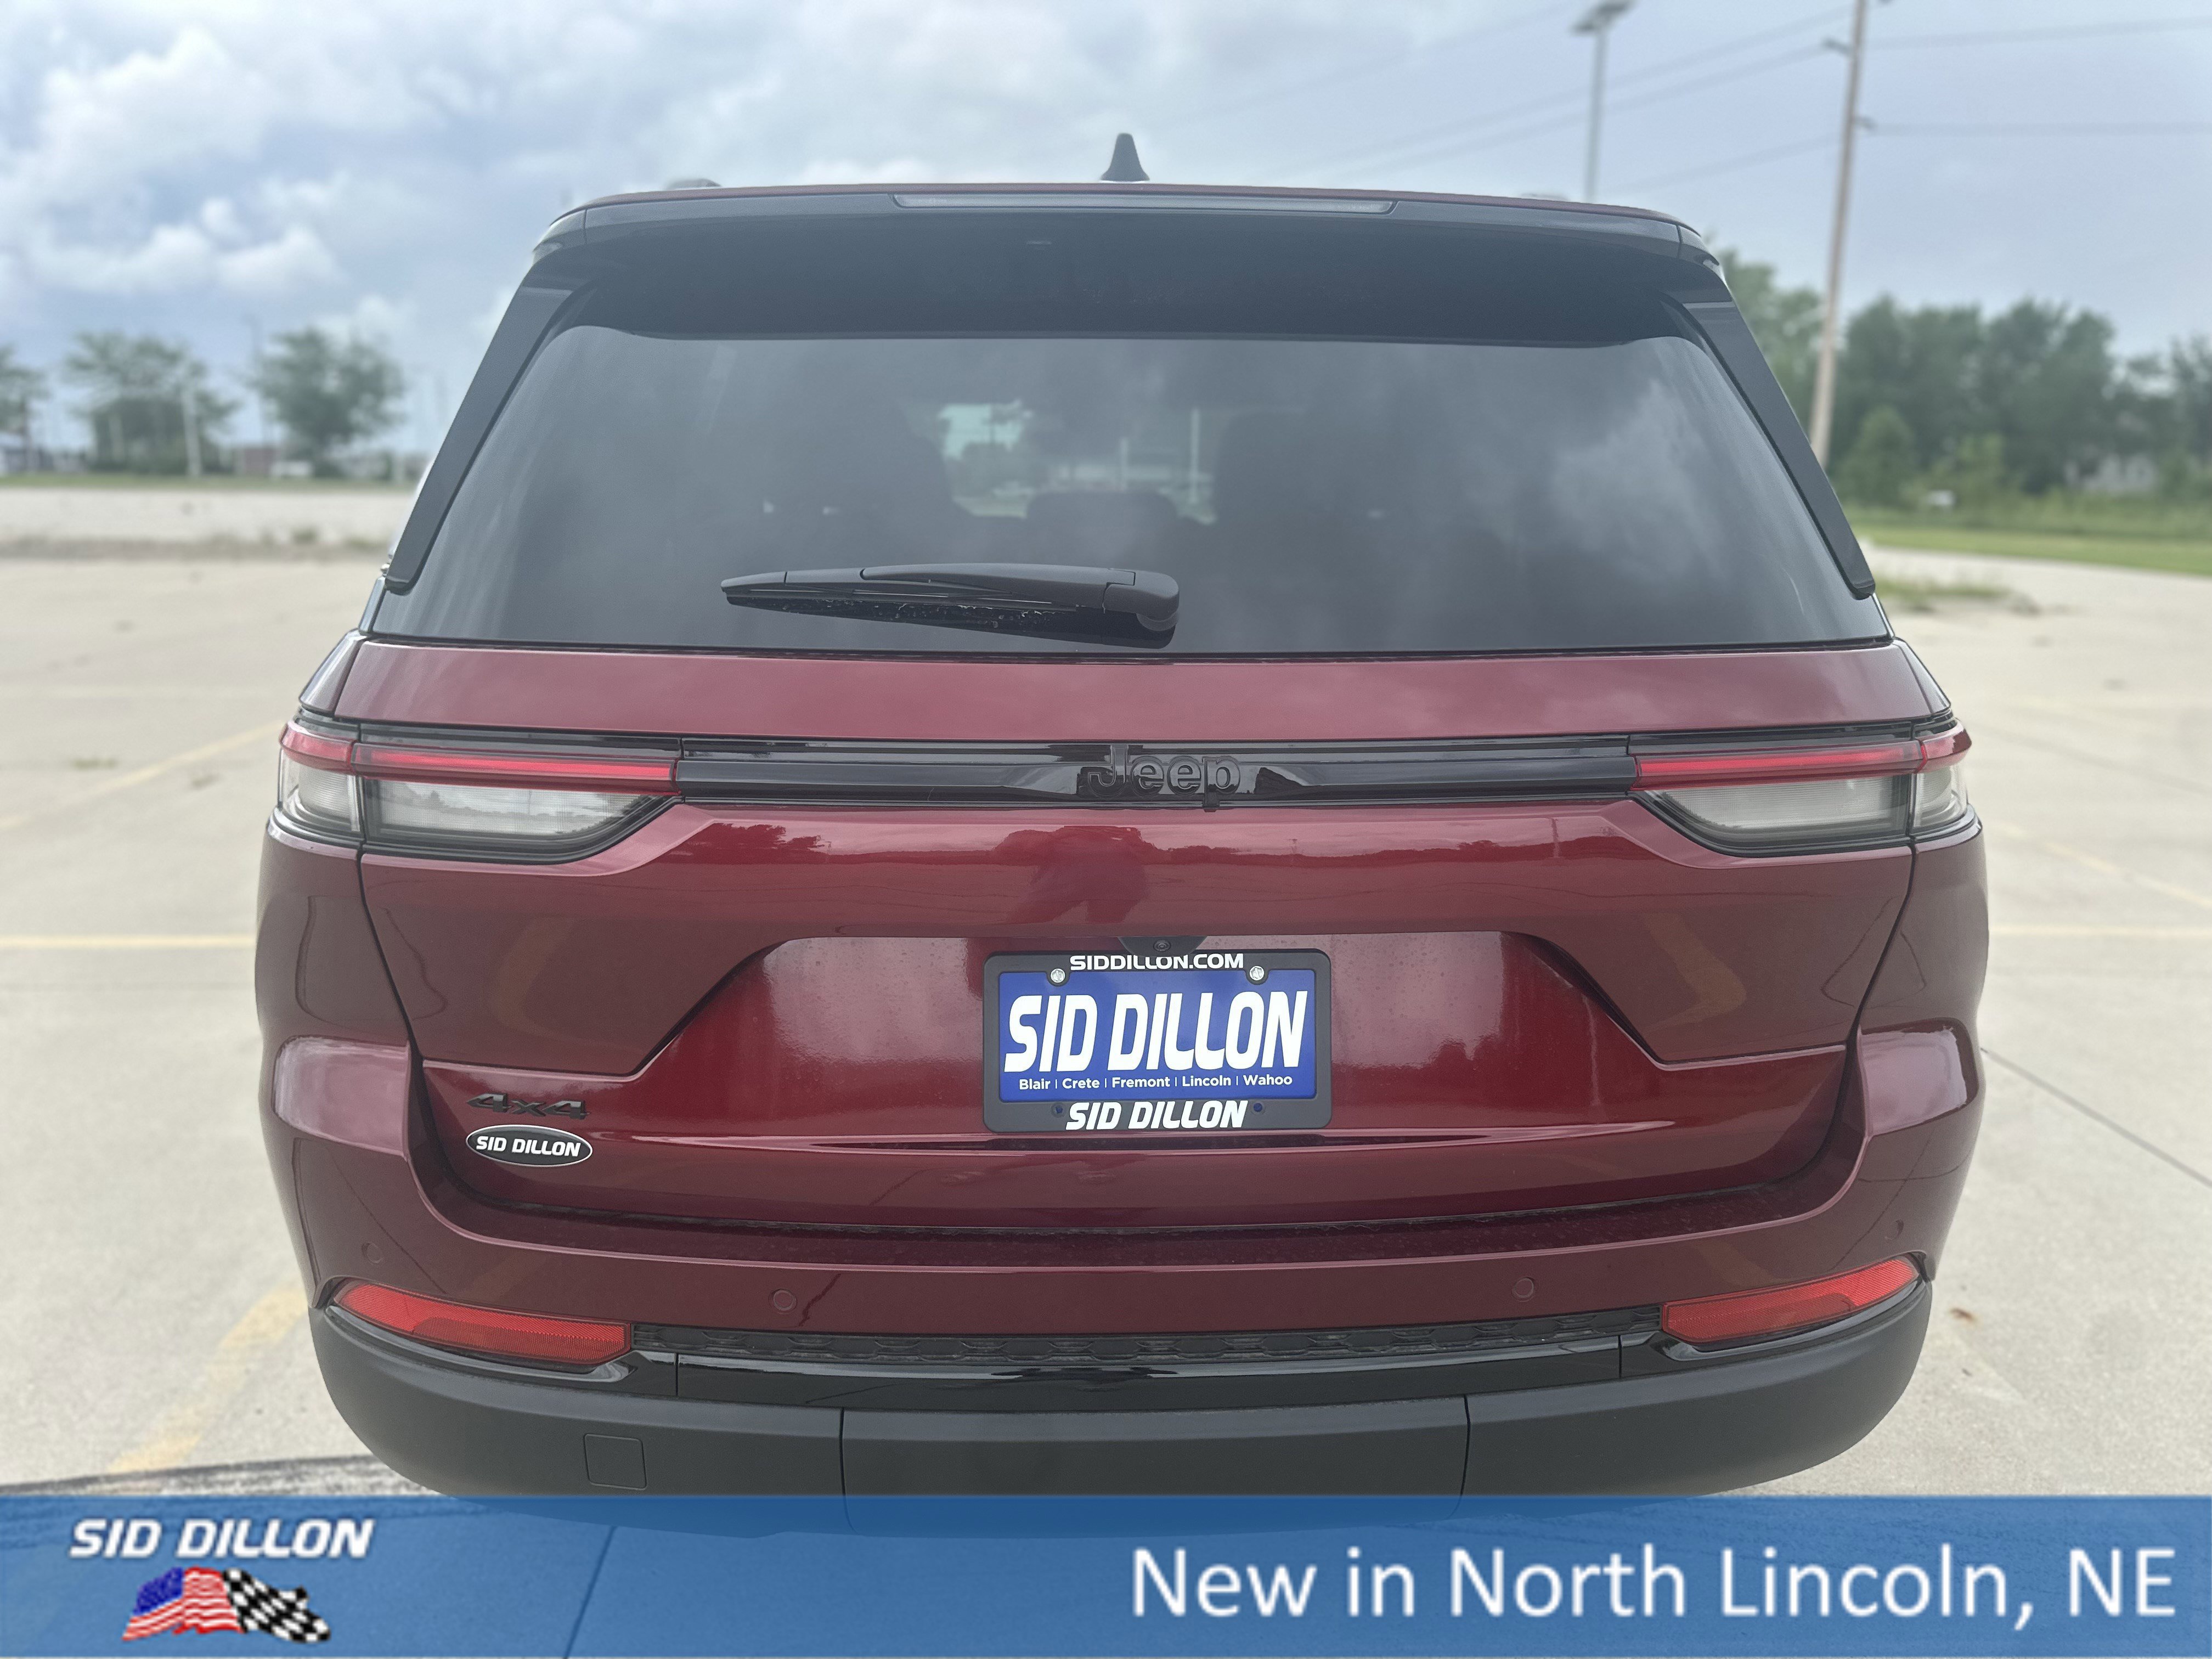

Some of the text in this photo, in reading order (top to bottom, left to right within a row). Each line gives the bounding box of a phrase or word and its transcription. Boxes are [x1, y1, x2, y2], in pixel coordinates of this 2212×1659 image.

[1087, 744, 1241, 812] Jeep
[1069, 953, 1244, 970] SIDDILLON.COM
[1003, 990, 1308, 1073] SID DILLON
[1019, 1074, 1293, 1091] Blair Crete Fremont Lincoln Wahoo
[466, 1092, 590, 1120] 4x4
[1065, 1099, 1249, 1131] SID DILLON
[476, 1136, 582, 1157] SID DILLON
